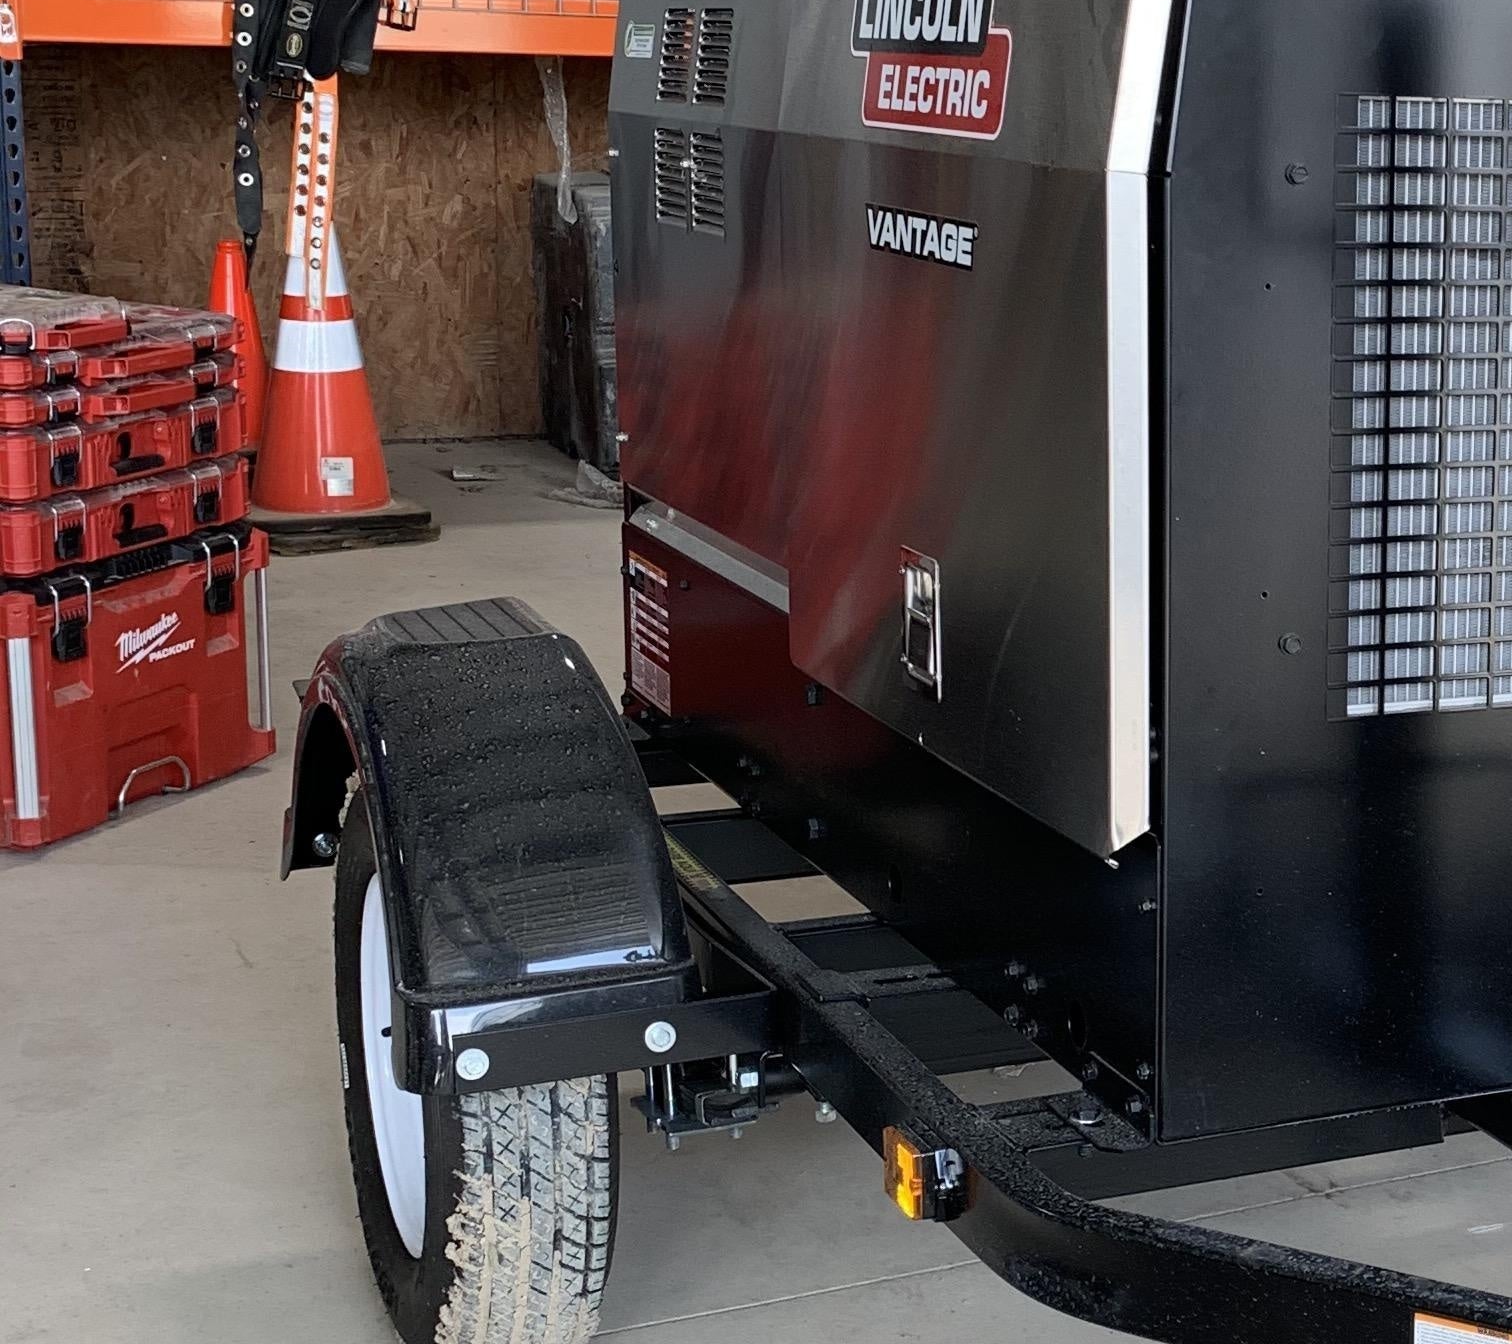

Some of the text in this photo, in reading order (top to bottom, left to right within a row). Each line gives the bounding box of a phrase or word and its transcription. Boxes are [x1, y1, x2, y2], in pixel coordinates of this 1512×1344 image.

[877, 64, 991, 119] ELECTRIC
[867, 209, 974, 267] VANTAGE
[114, 611, 179, 662] Milwaukee
[149, 638, 196, 663] PACKOUT
